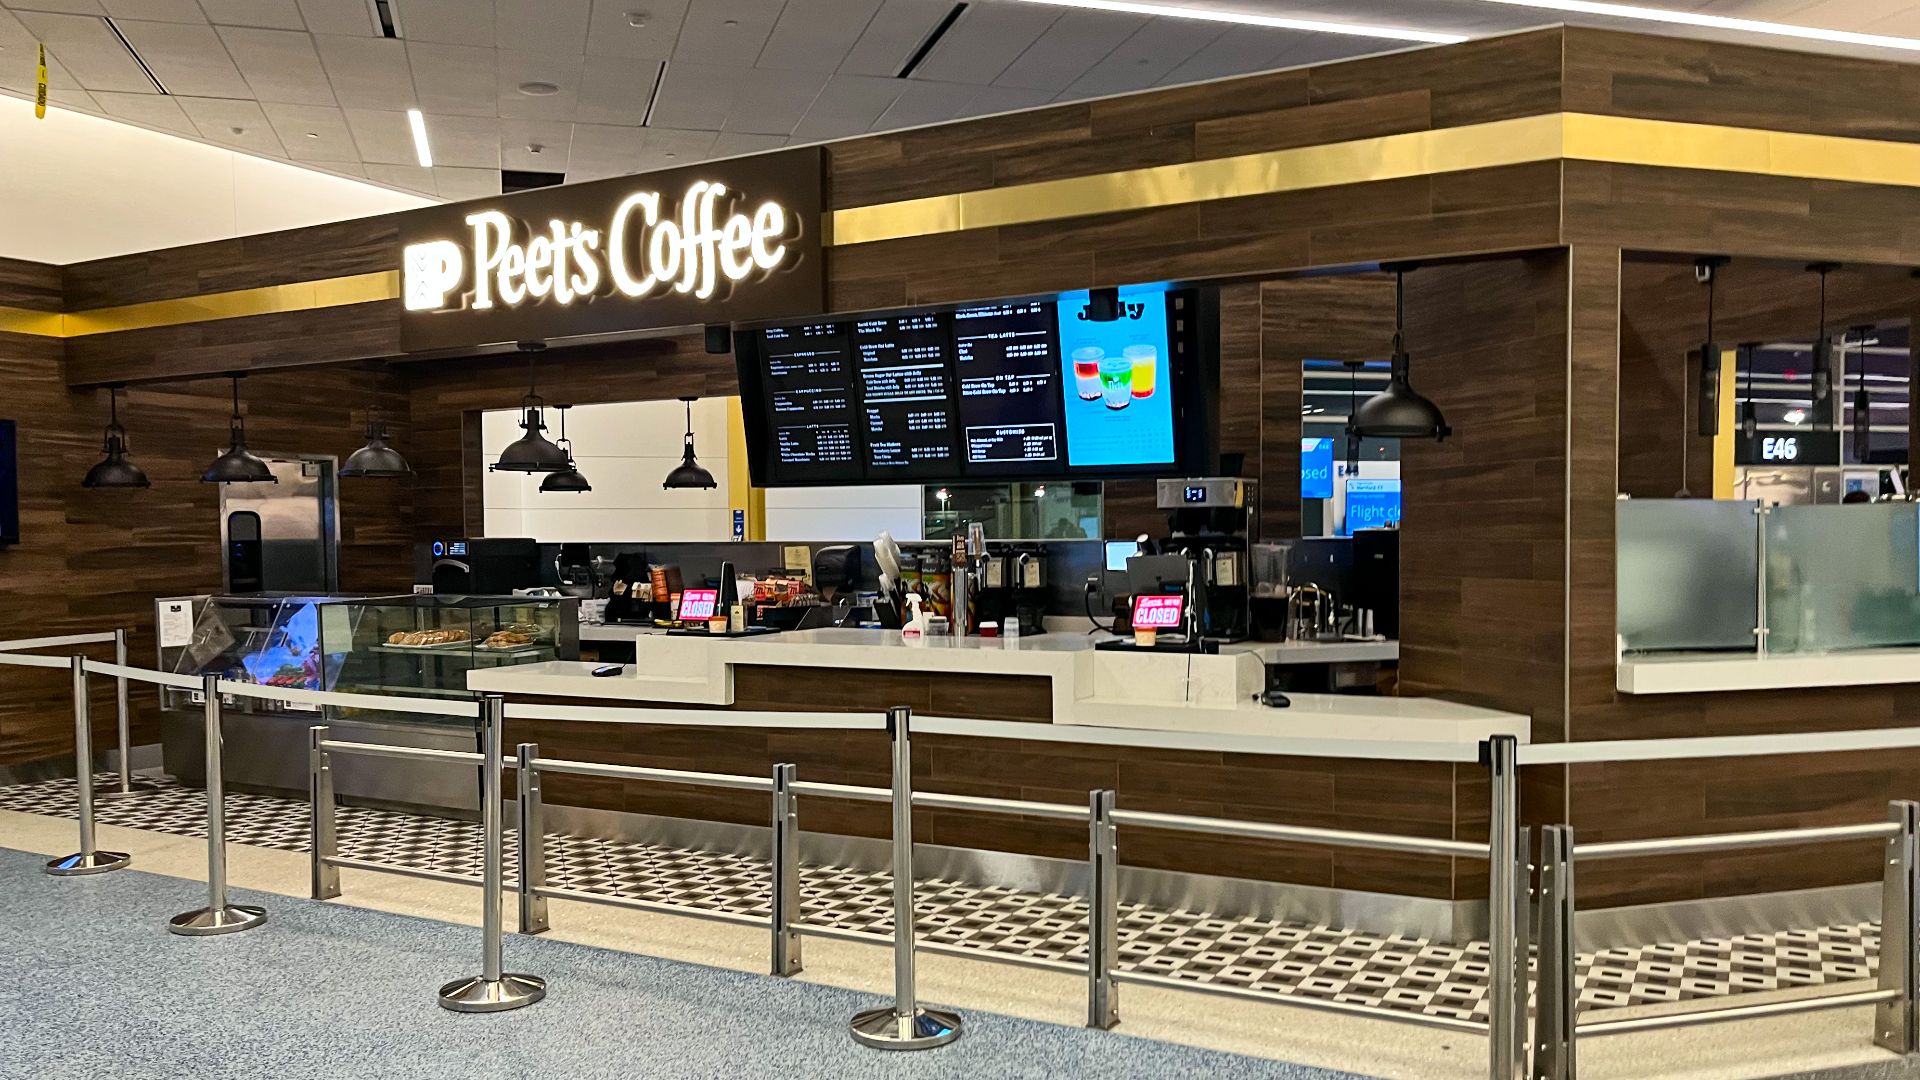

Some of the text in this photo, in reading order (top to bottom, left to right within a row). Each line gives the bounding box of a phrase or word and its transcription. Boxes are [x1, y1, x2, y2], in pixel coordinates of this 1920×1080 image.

[466, 210, 600, 309] Peet's
[609, 181, 786, 300] Coffee
[1077, 301, 1145, 320] Jly
[1762, 437, 1797, 460] E46
[1351, 505, 1384, 522] Flight
[682, 601, 714, 617] CLOSED
[1136, 607, 1178, 623] CLOSED
